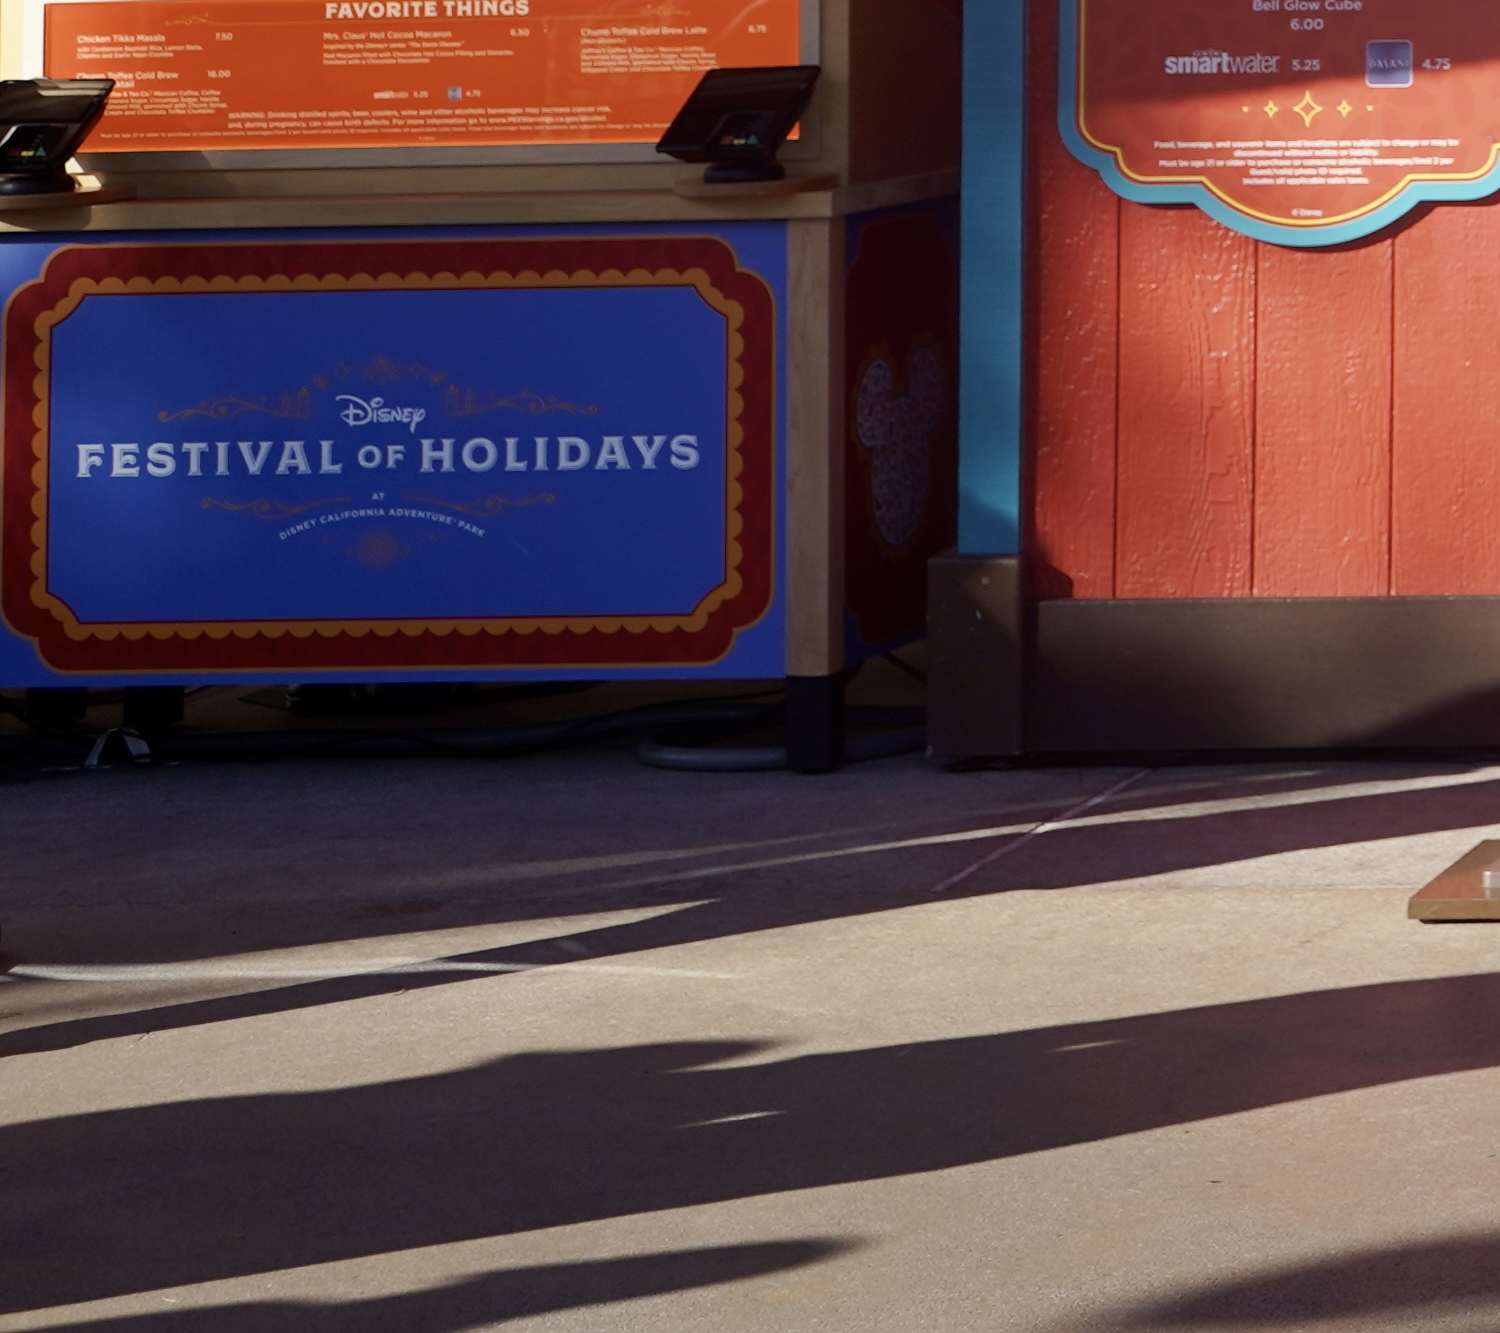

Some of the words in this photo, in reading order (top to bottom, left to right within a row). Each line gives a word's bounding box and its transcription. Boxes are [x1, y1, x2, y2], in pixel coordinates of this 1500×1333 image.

[326, 1, 437, 18] FAVORITE
[443, 0, 529, 16] THINGS
[1252, 0, 1280, 11] Bell
[1284, 0, 1320, 11] Glow
[1324, 0, 1362, 10] Cube
[1290, 18, 1324, 30] 6.00
[1164, 53, 1281, 75] smartwater
[1292, 59, 1320, 71] 5.25
[1422, 58, 1451, 69] 4.75
[335, 394, 426, 432] Disney
[76, 440, 343, 478] FESTIVAL
[358, 445, 405, 468] OF
[419, 435, 700, 474] HOLIDAYS
[371, 492, 385, 501] AT
[278, 518, 317, 541] DISNEY
[320, 508, 386, 525] CALIFORNIA
[457, 520, 486, 538] PARK
